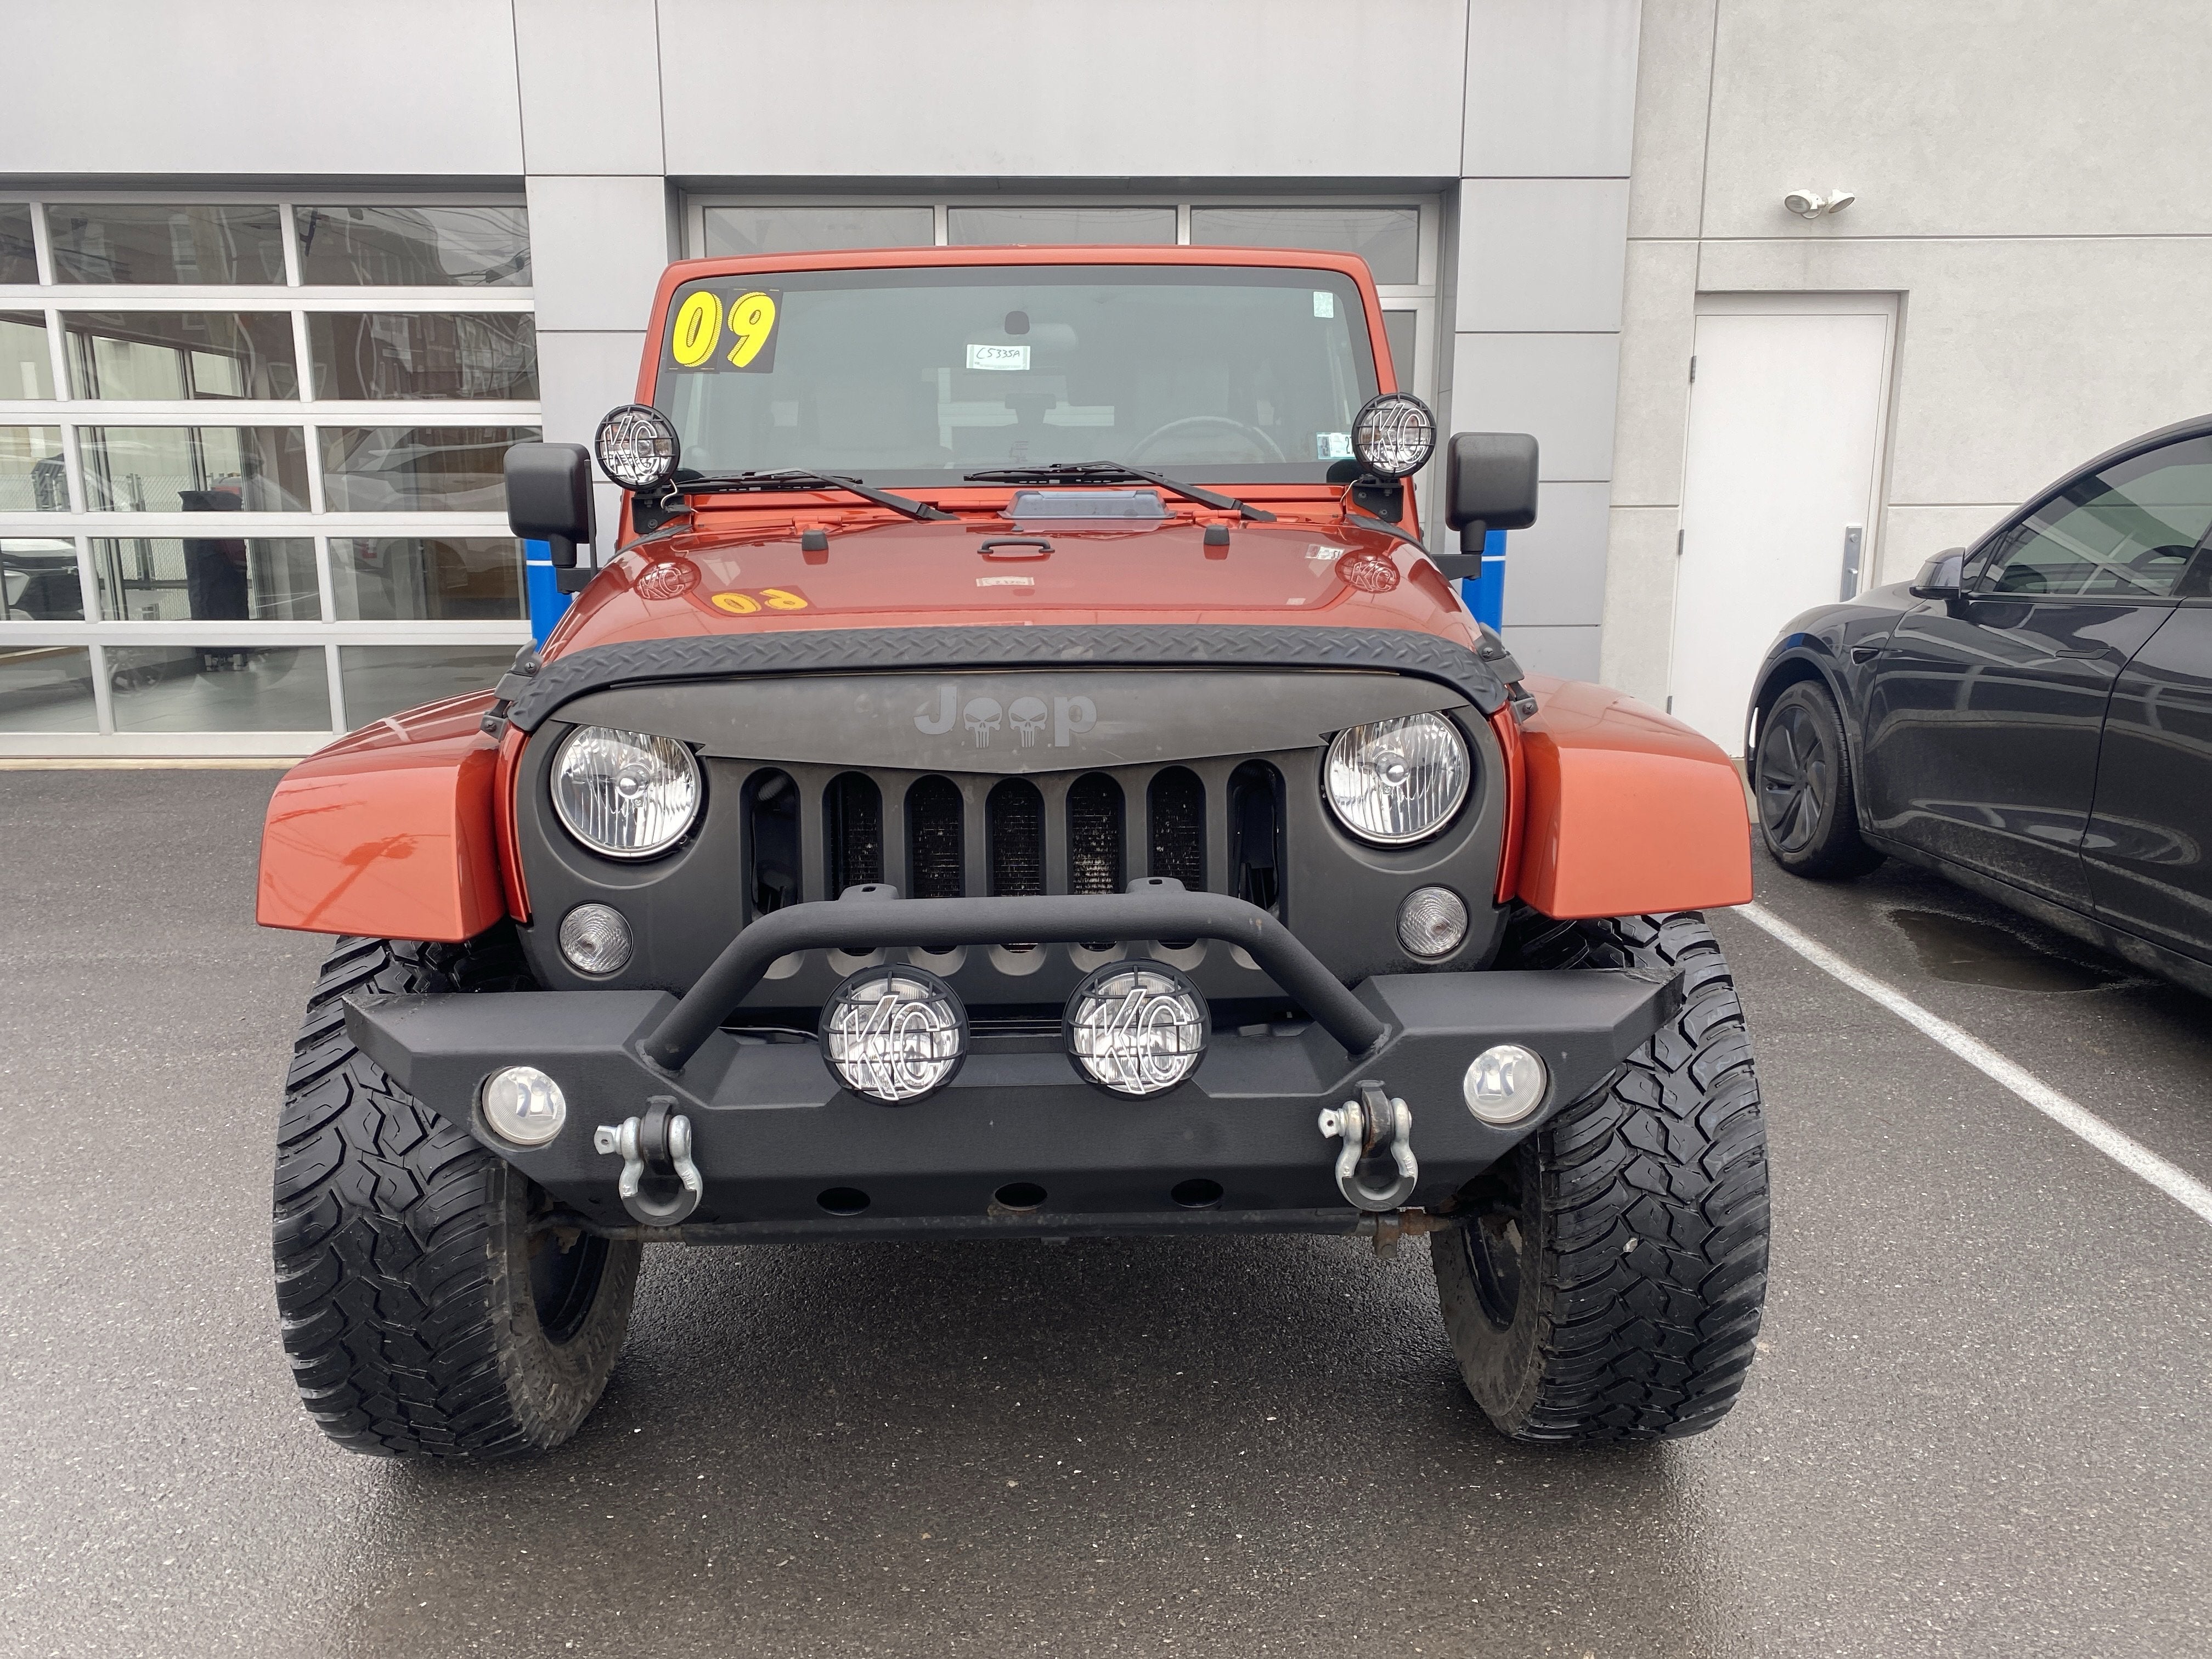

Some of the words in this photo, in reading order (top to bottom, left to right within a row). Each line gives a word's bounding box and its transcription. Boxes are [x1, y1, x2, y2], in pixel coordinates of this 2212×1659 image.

[673, 291, 776, 368] 09
[977, 347, 1020, 359] C5335A
[603, 415, 658, 481] KC
[1371, 403, 1427, 467] KC
[913, 686, 1097, 748] Jeep
[843, 994, 941, 1101] KC
[1092, 988, 1188, 1094] KC
